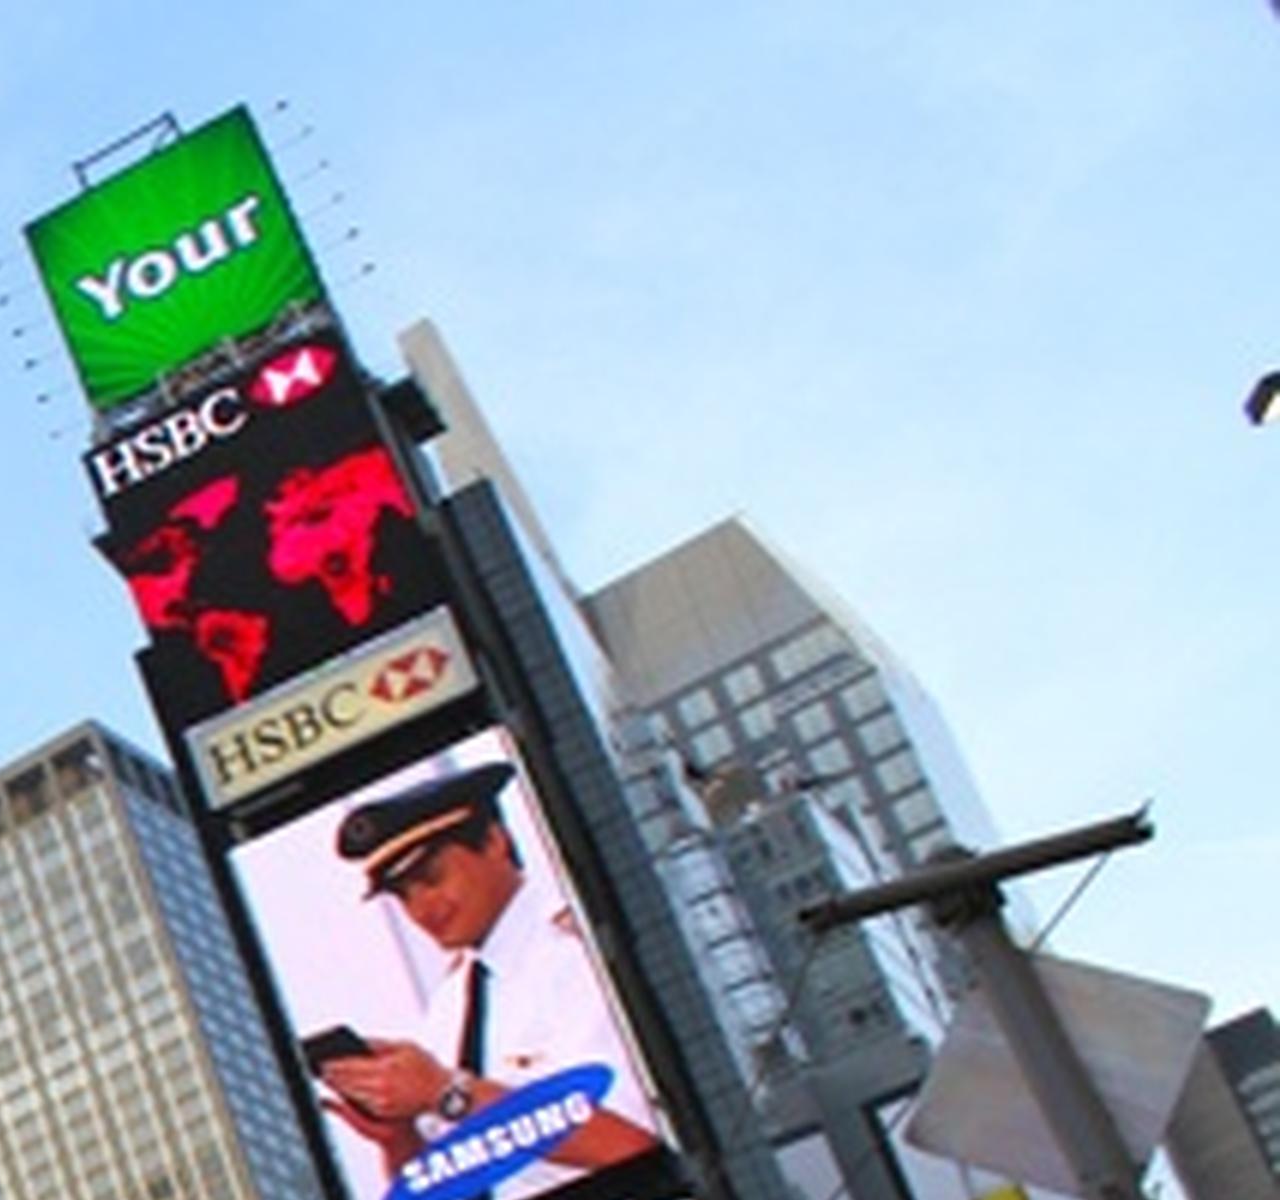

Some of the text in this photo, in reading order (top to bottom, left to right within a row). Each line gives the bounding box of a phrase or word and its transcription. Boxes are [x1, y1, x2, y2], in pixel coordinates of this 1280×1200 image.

[74, 195, 261, 321] Your
[93, 389, 249, 496] HSBC
[208, 681, 370, 787] HSBC
[402, 1093, 594, 1192] SAMSUNG
